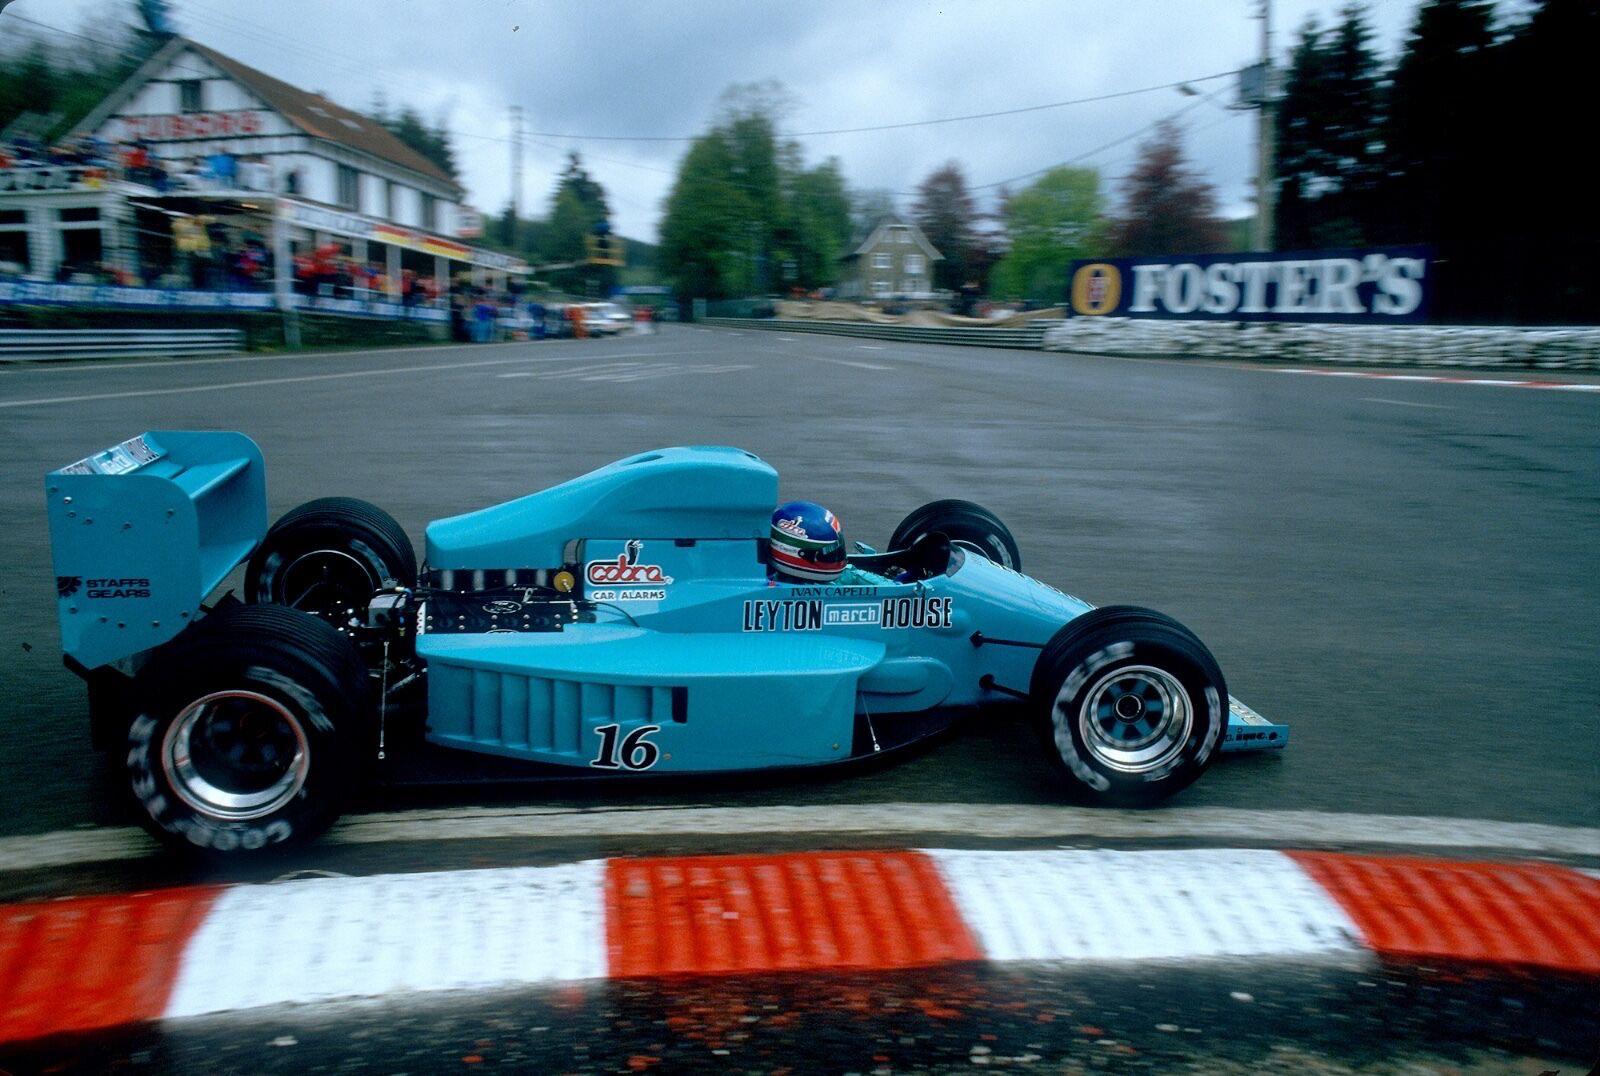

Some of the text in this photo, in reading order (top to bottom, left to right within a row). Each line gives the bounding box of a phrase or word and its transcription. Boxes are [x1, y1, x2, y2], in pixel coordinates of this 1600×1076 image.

[1129, 254, 1426, 316] FOSTER'S
[590, 554, 664, 582] cobra
[86, 578, 150, 588] STAFFS
[791, 586, 878, 597] IVAN CAPELLI
[87, 589, 151, 599] GEARS
[593, 590, 665, 600] CAR ALARMS
[743, 597, 952, 632] LEYTON march HOUSE
[589, 723, 660, 771] 16
